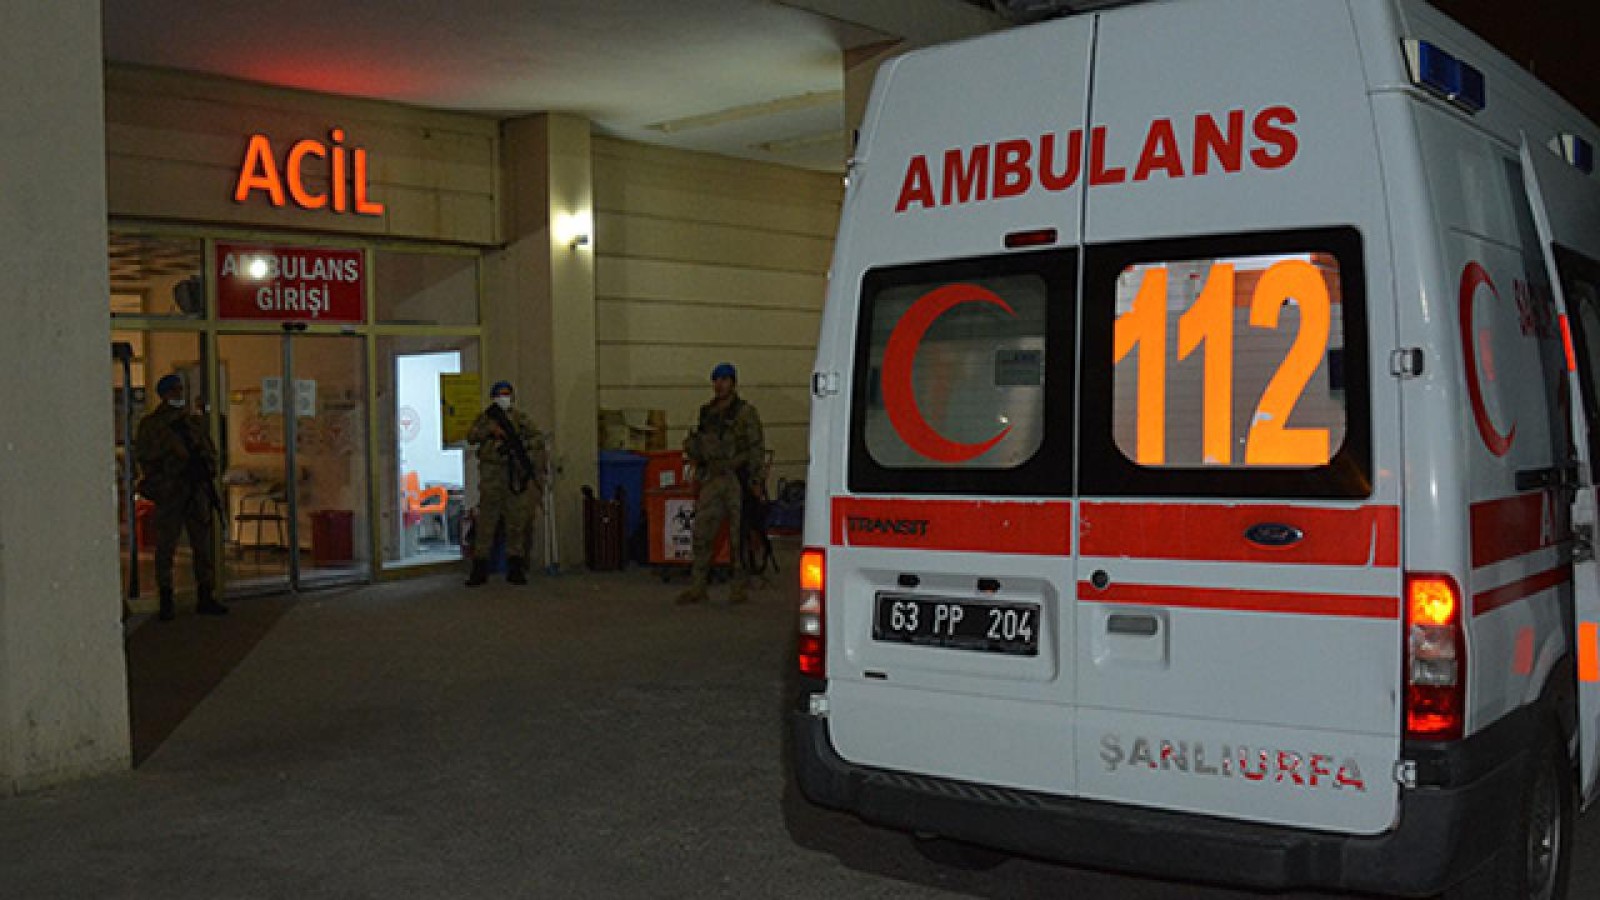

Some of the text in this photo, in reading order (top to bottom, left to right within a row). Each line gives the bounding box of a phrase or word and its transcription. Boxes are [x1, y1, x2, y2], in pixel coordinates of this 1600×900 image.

[235, 129, 384, 215] ACİL
[895, 106, 1298, 213] AMBULANS
[221, 252, 359, 283] ABULANS
[256, 281, 330, 317] GİRİŞİ
[1114, 259, 1331, 465] 112
[891, 601, 1031, 643] 63 PP 204
[1100, 733, 1365, 792] ŞANLIURFA
